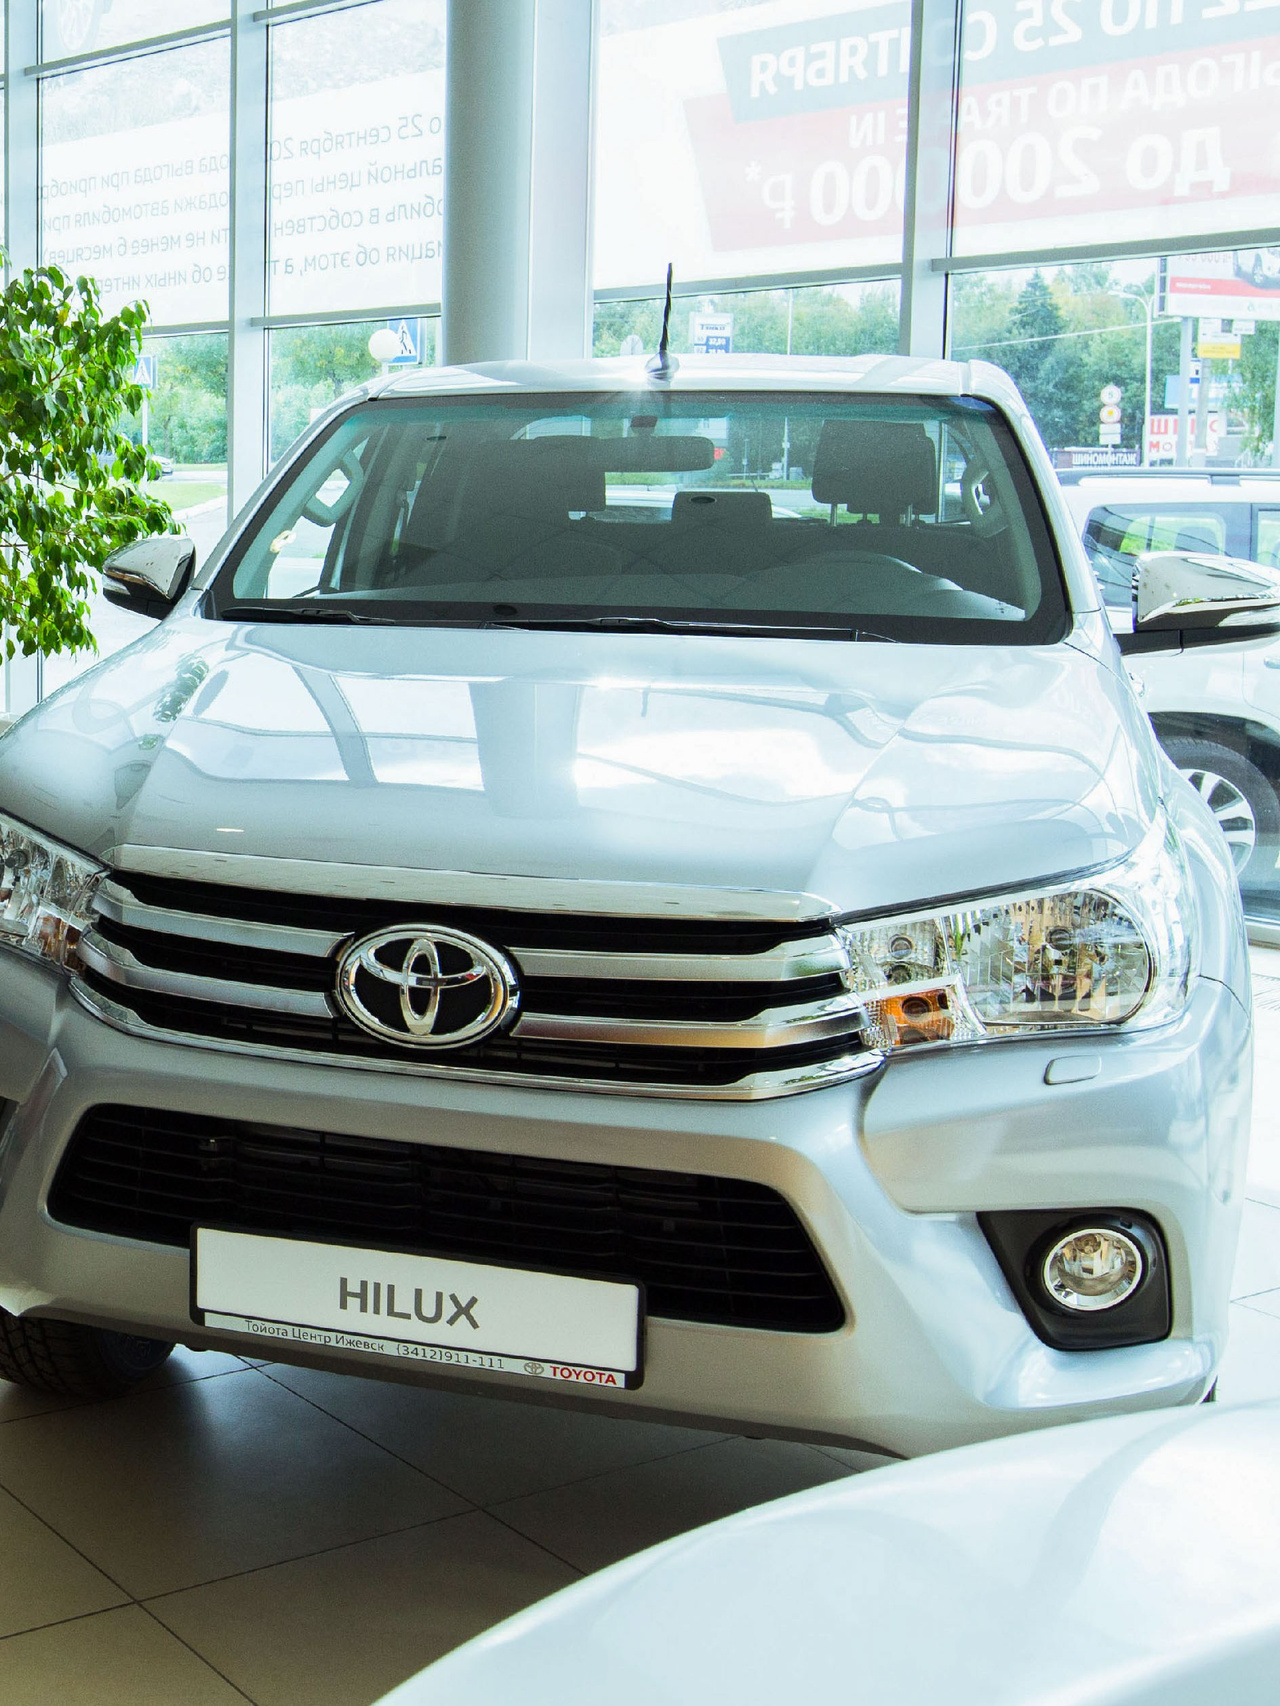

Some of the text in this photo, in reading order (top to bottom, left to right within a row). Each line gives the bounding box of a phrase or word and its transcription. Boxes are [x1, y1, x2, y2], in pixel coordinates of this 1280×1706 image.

[339, 1276, 481, 1330] HILUX
[245, 1319, 289, 1338] Тойота
[291, 1327, 332, 1345] Центр
[334, 1334, 385, 1352] Ижевск
[549, 1365, 618, 1386] TOYOTA
